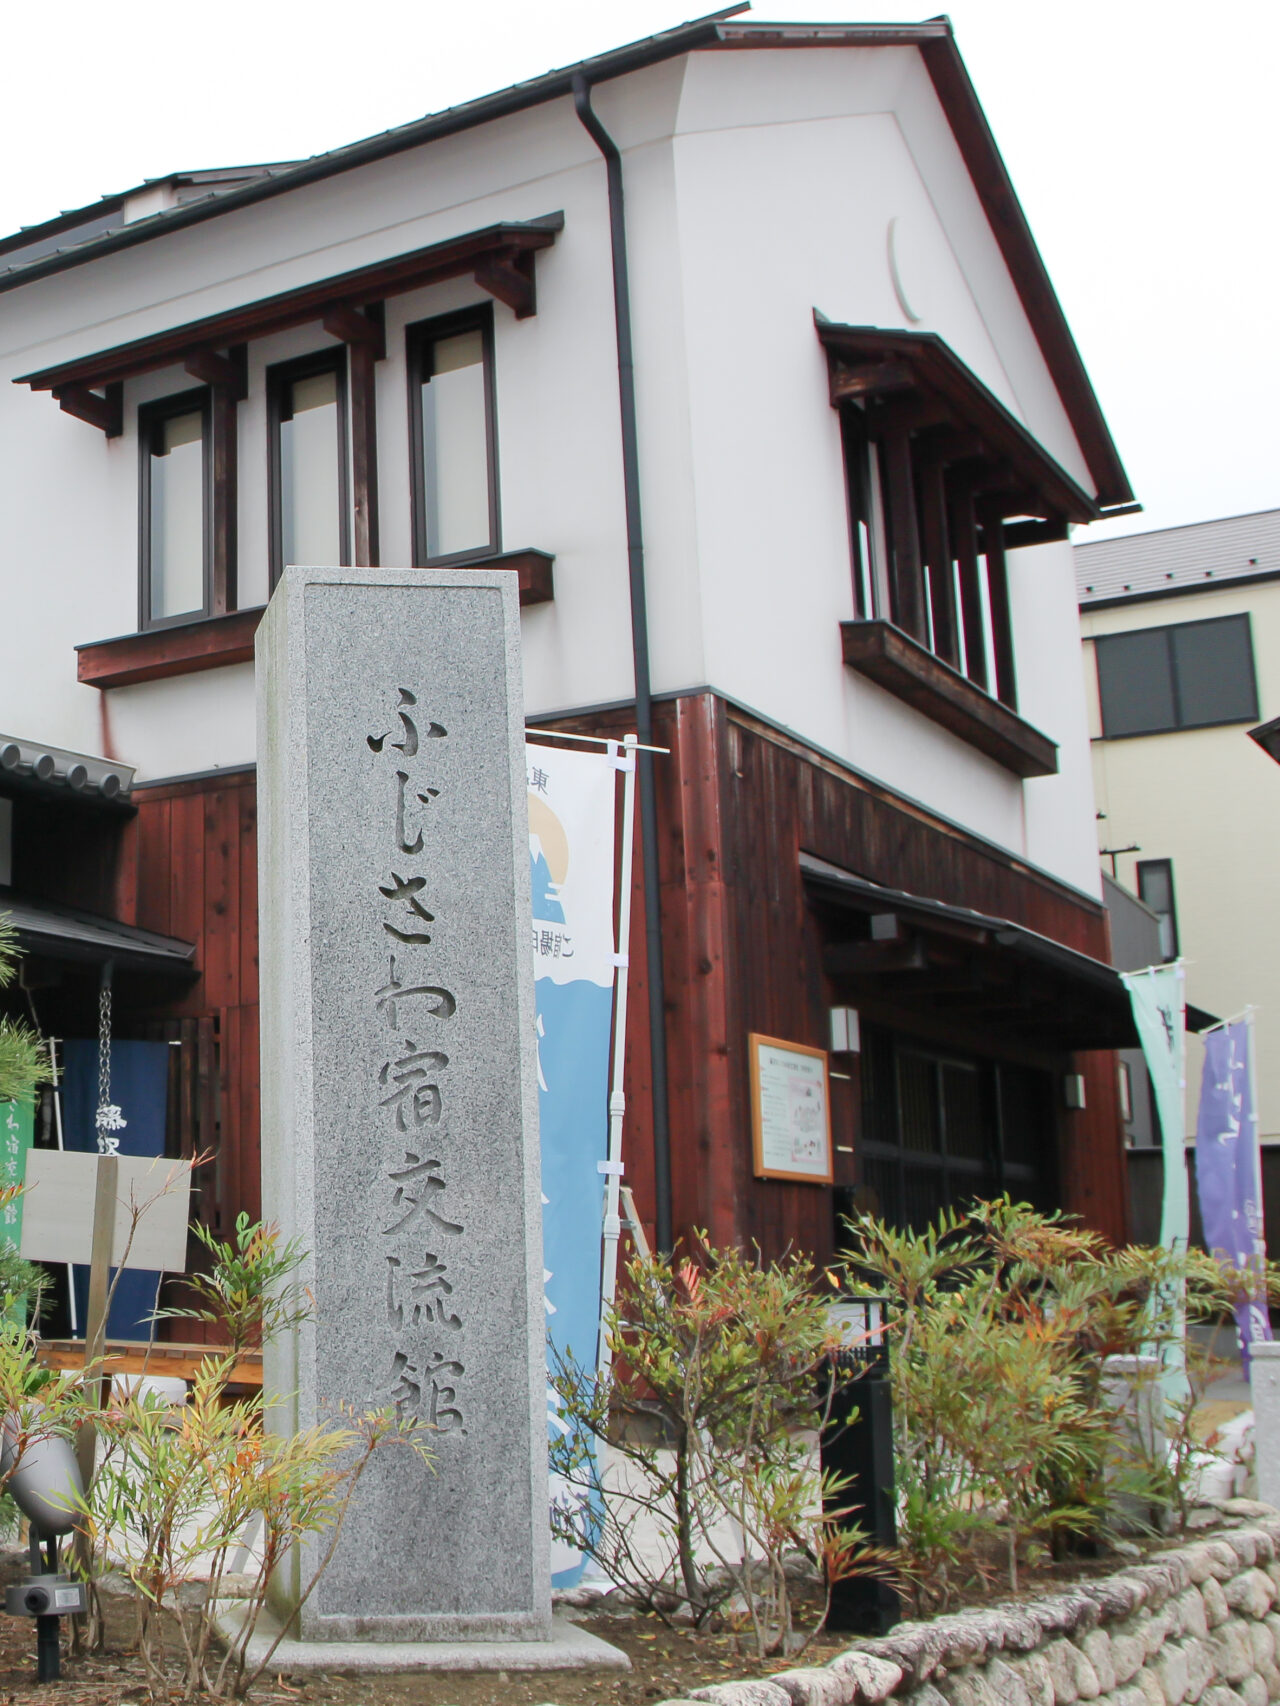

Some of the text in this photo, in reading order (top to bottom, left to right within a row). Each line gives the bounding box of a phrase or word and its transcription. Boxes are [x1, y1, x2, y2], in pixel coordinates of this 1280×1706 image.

[366, 687, 467, 1438] ふじさわ宿交流館
